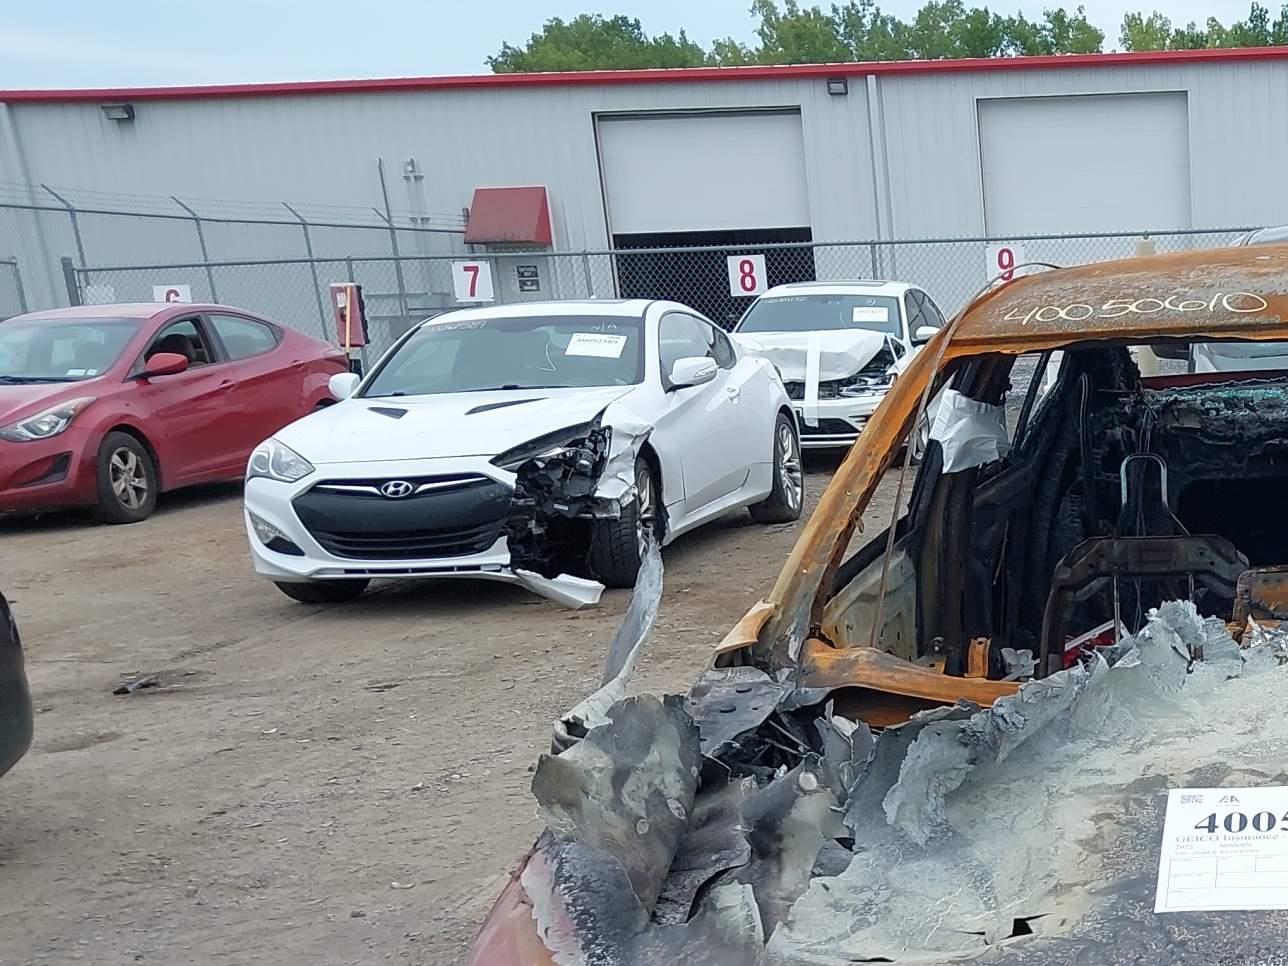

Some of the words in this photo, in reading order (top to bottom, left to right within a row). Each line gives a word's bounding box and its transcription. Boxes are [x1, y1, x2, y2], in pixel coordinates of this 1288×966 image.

[739, 259, 757, 292] 8
[997, 247, 1015, 281] 9
[463, 266, 480, 297] 7
[1003, 292, 1268, 325] 40050610
